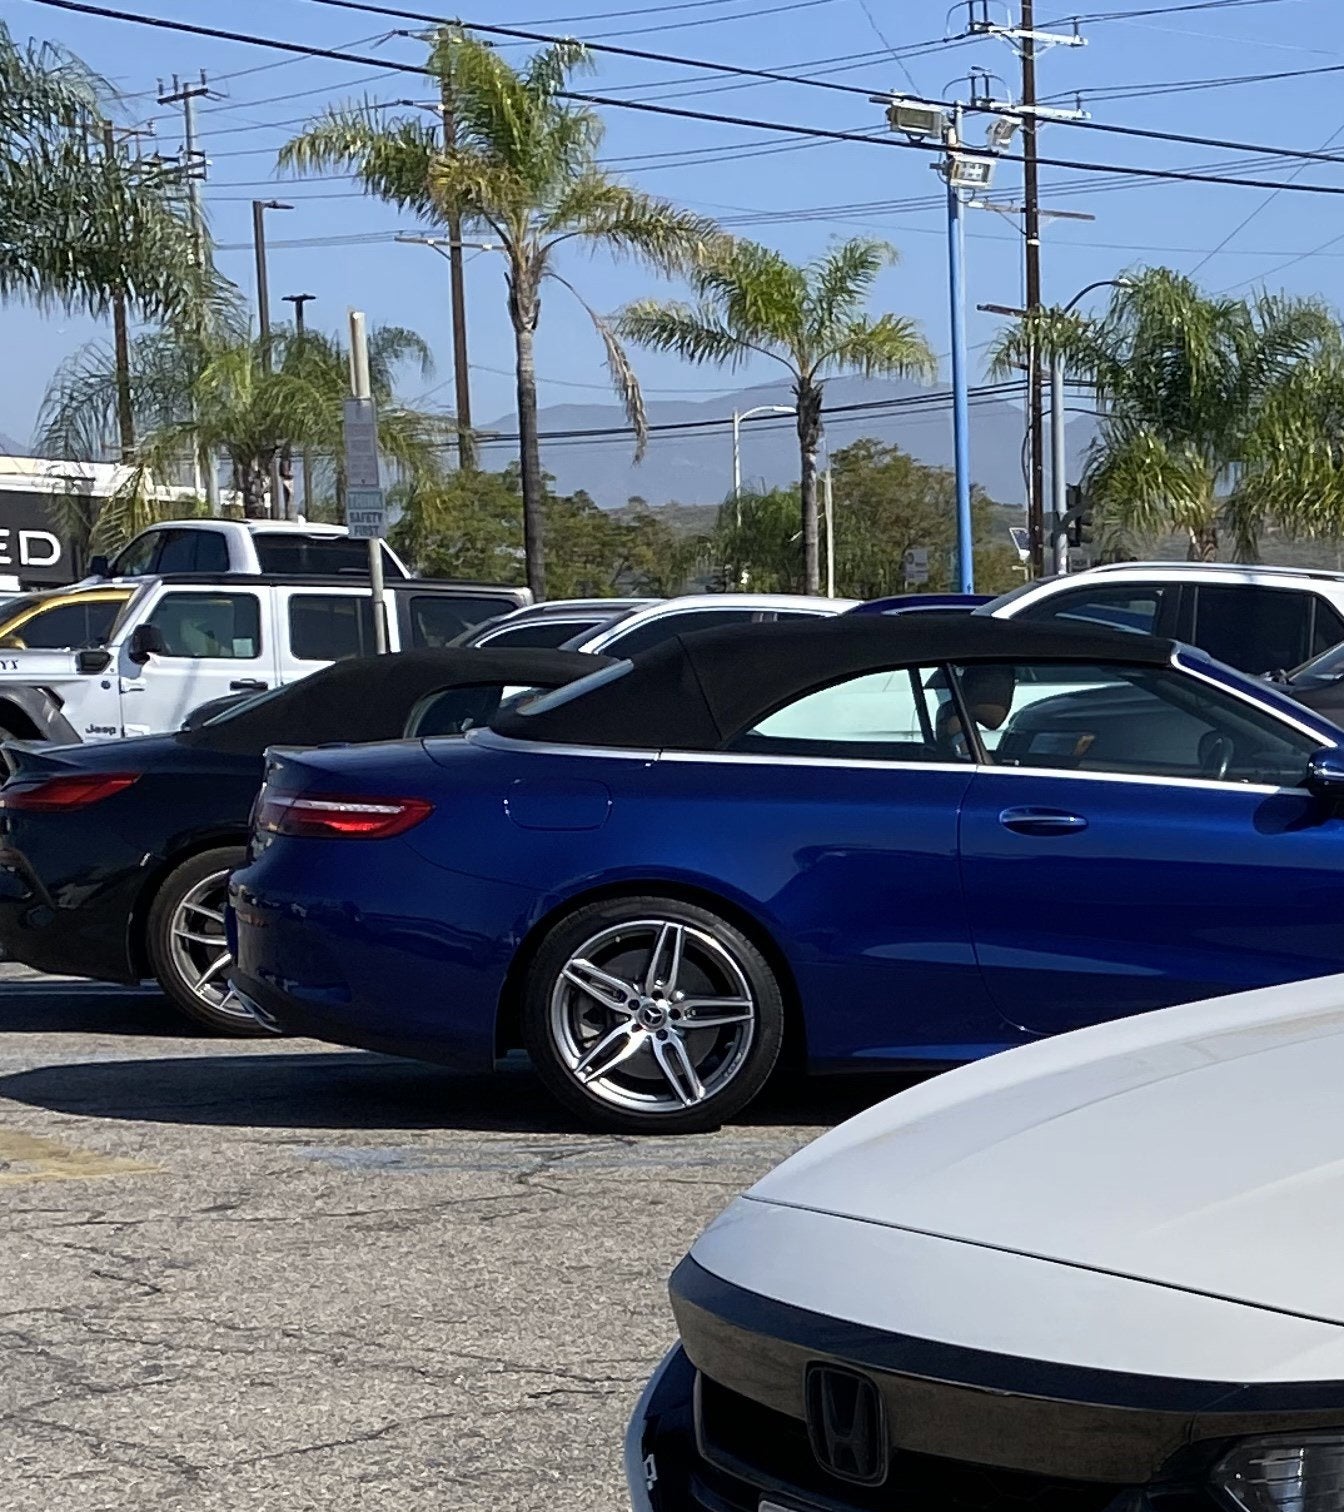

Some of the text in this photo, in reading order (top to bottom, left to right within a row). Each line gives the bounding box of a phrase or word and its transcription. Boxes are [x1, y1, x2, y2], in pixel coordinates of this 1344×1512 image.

[349, 511, 383, 523] SAFETY
[354, 525, 379, 536] FIRST
[85, 723, 116, 736] Jeep
